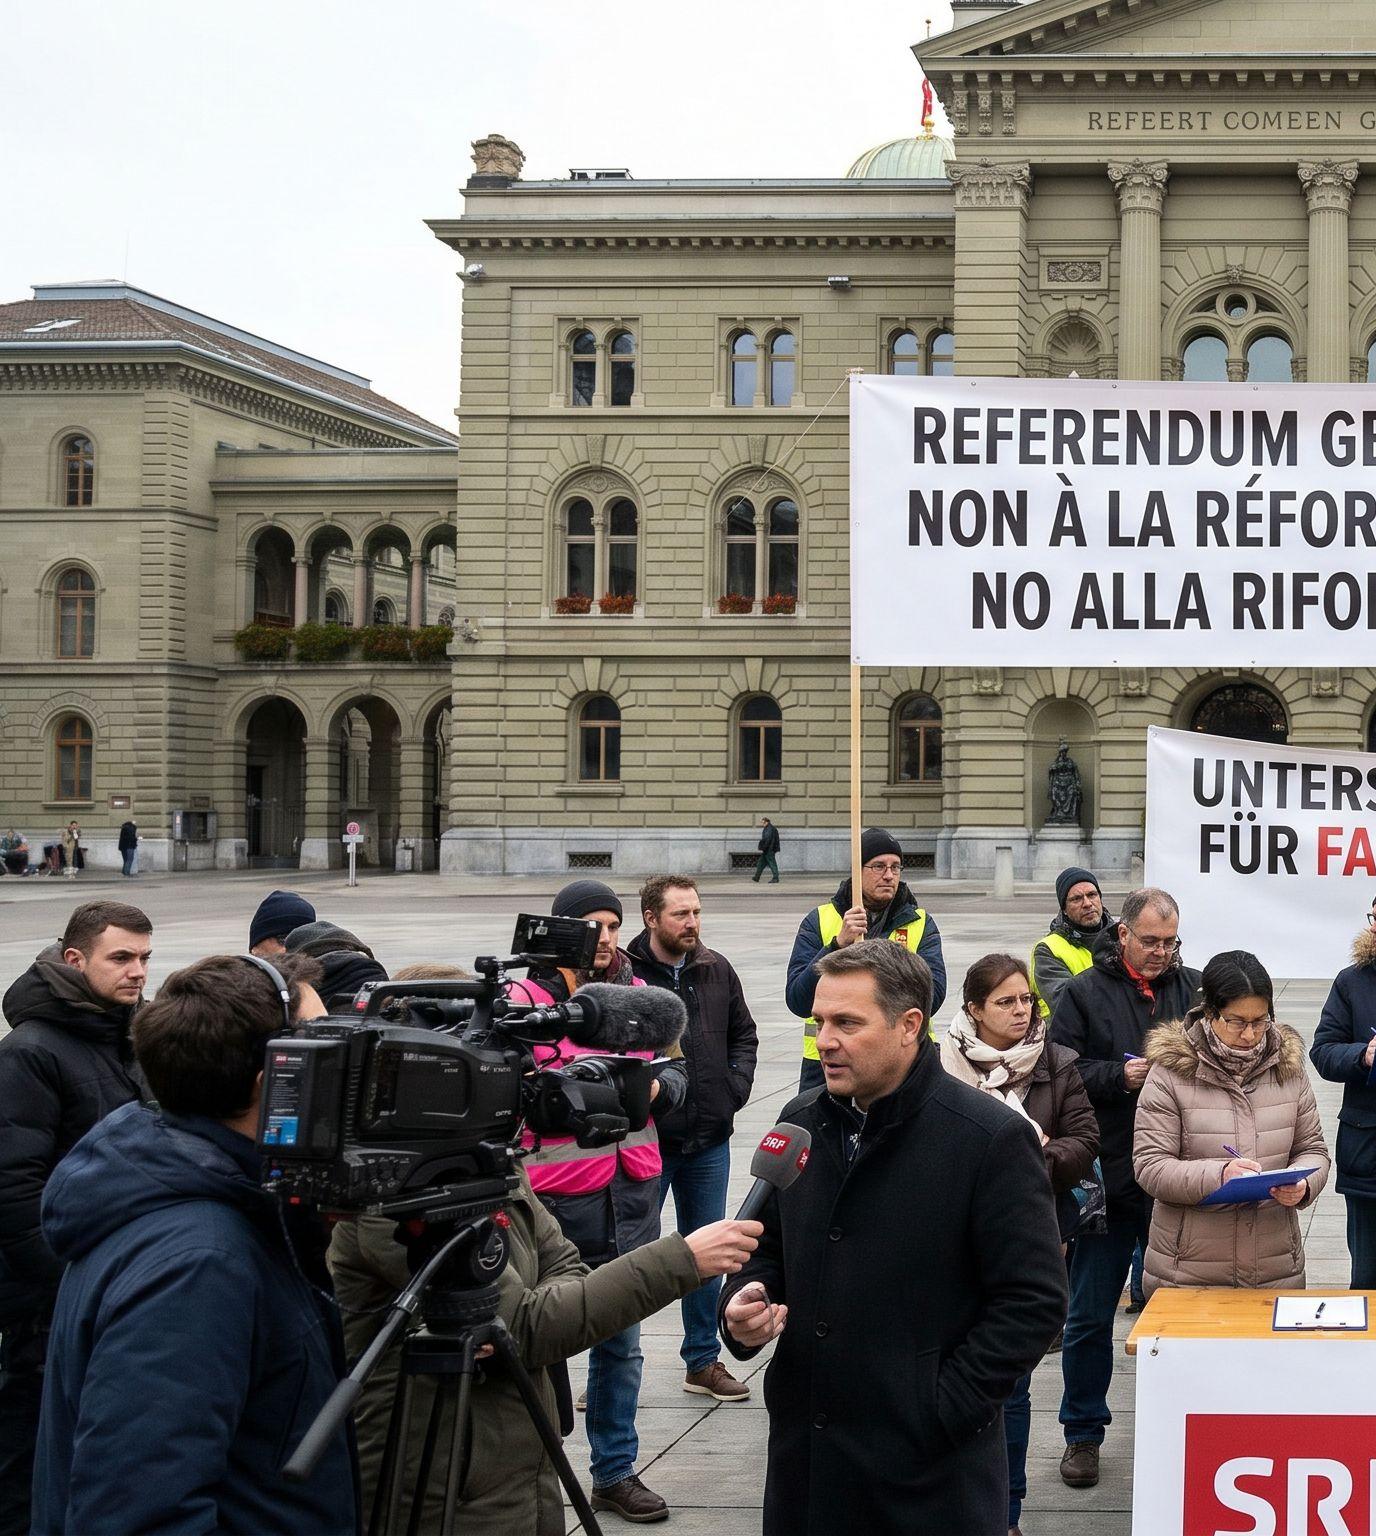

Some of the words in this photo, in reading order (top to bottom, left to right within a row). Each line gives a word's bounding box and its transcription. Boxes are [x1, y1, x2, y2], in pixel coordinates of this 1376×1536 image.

[1087, 110, 1212, 130] REFEERT
[1223, 110, 1342, 130] COMEEN
[914, 407, 1297, 467] REFERENDUM
[909, 490, 1027, 547] NON
[1049, 472, 1088, 547] À
[1108, 490, 1176, 547] LA
[973, 572, 1050, 630] NO
[1071, 573, 1211, 629] ALLA
[1199, 811, 1299, 875] FÜR
